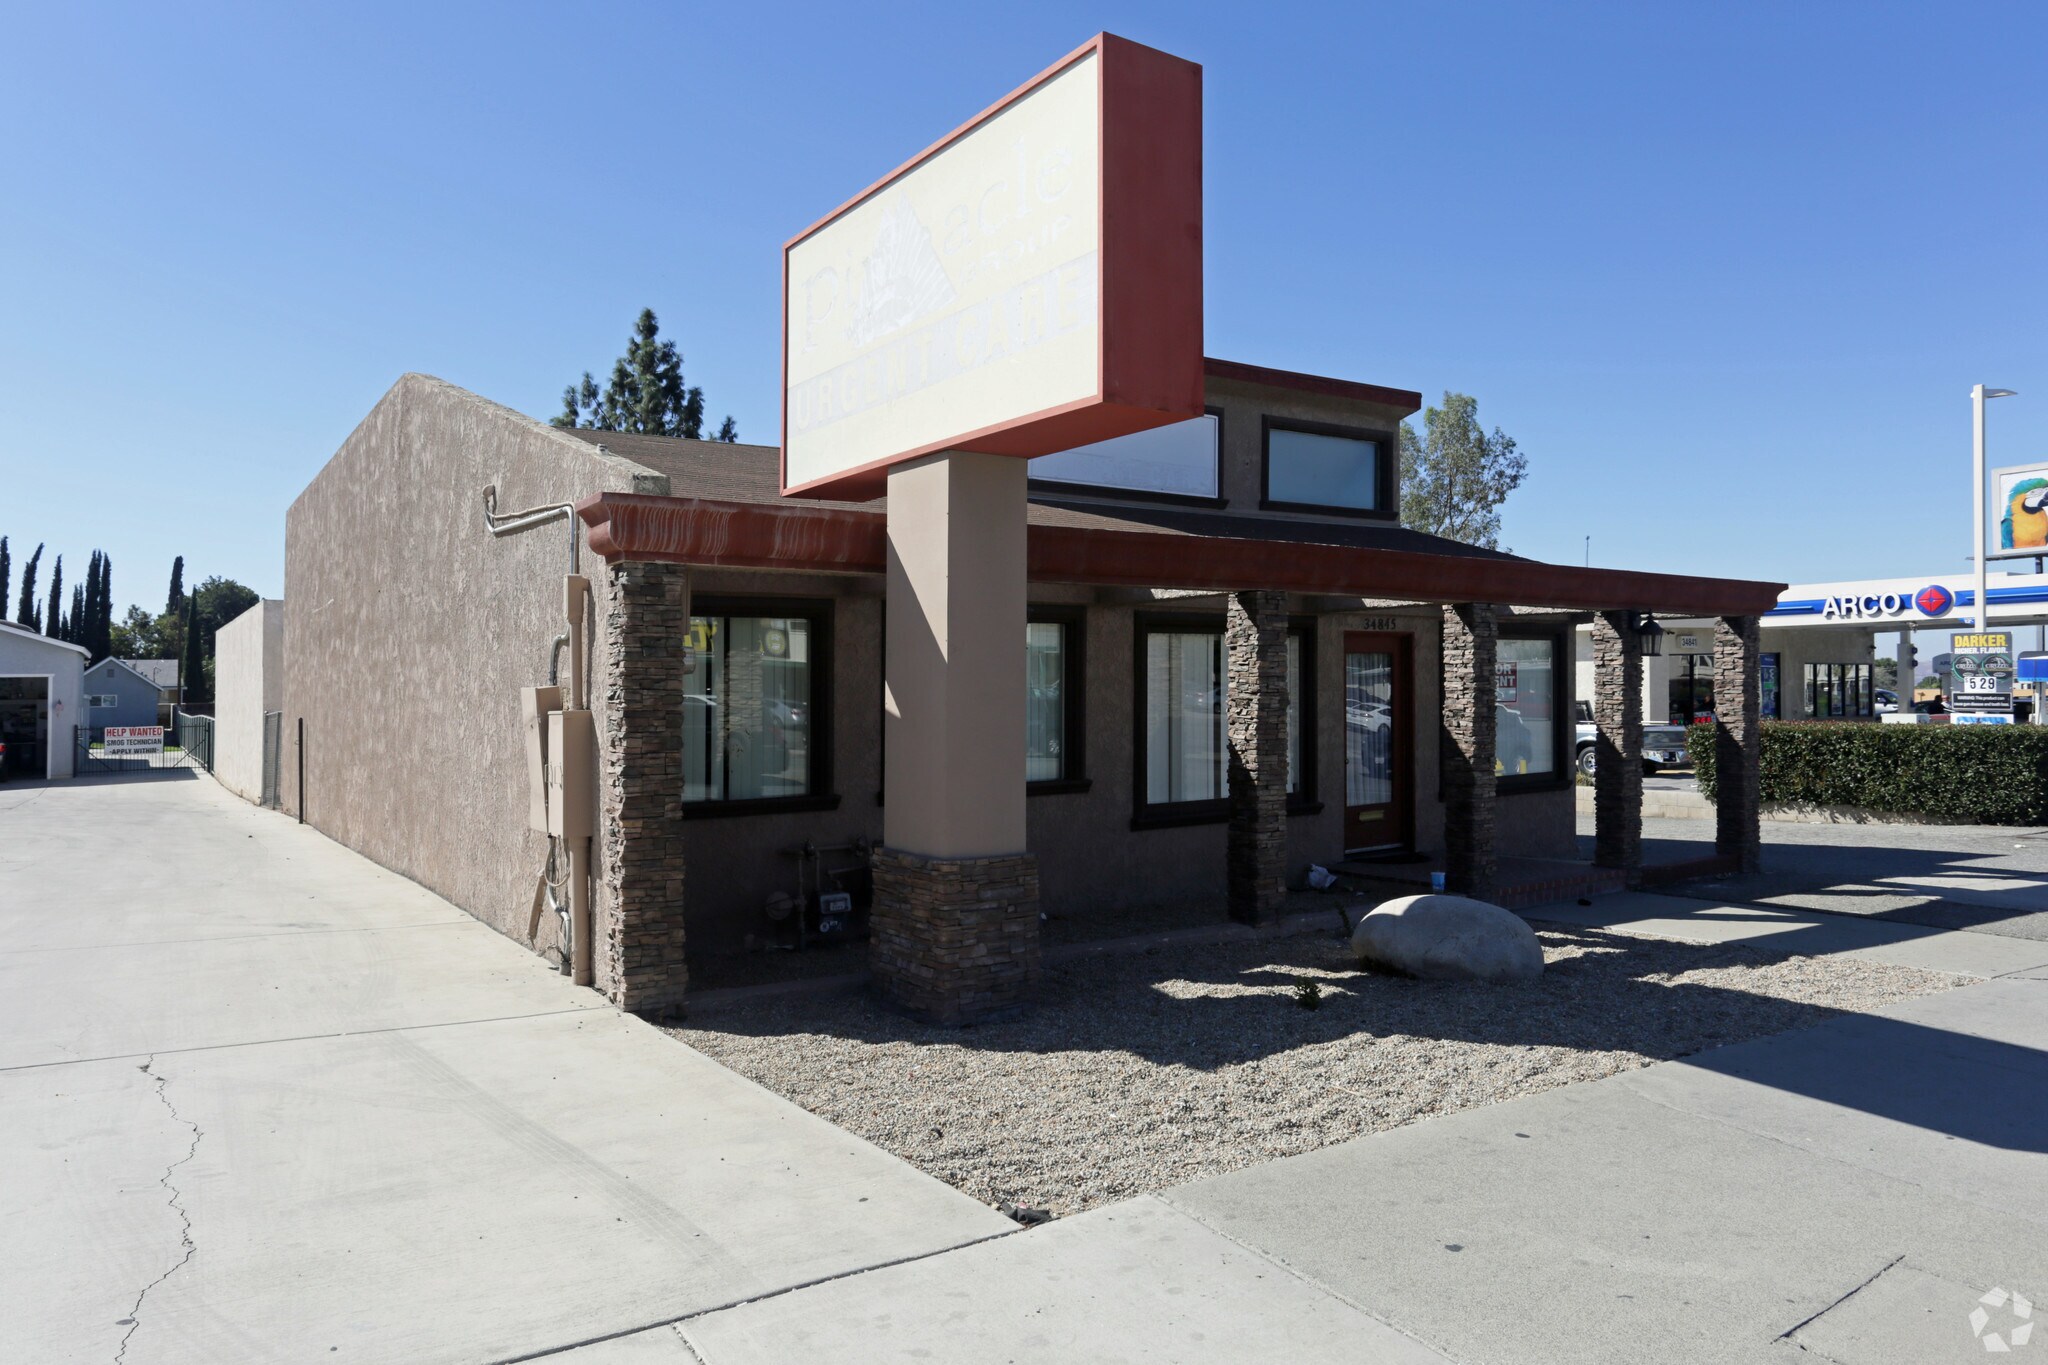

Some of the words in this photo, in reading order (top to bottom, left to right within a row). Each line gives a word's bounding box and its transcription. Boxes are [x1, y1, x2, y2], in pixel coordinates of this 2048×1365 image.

[1822, 592, 1901, 617] ARCO
[1494, 663, 1512, 675] OR
[106, 728, 127, 737] HELP
[129, 727, 162, 736] WANTED
[126, 738, 162, 746] TECHNICIAN
